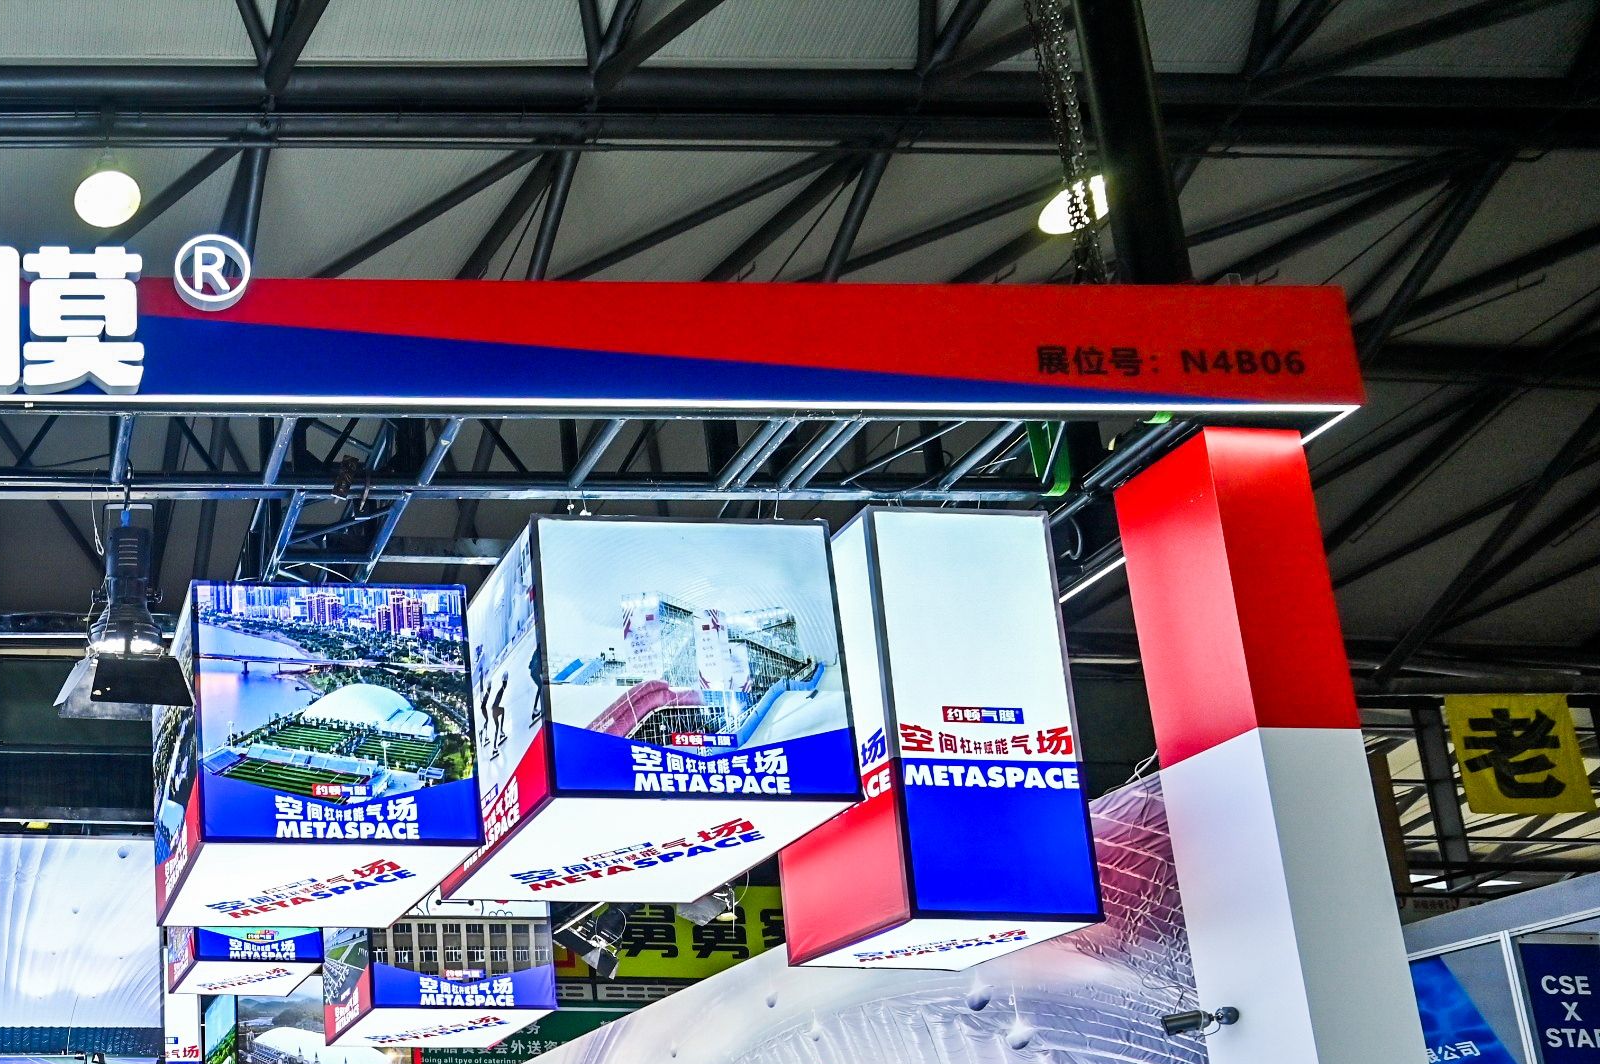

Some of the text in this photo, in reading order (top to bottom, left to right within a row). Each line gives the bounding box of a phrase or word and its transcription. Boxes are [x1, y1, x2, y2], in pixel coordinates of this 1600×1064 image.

[1180, 349, 1305, 375] N4B06
[900, 723, 1073, 756] 空间杠杆赋能气场
[631, 745, 788, 775] 空间杠杆赋能气场
[1463, 707, 1566, 800] 老
[634, 772, 792, 795] METASPACE
[904, 763, 1080, 790] METASPACE
[275, 796, 418, 822] 空间杠杆赋能气场
[276, 821, 420, 841] METASPACE
[530, 830, 766, 892] METASPACE
[228, 868, 418, 919] METASPACE
[1541, 975, 1591, 995] CSE
[419, 993, 515, 1007] METASPACE
[1561, 1002, 1583, 1022] X
